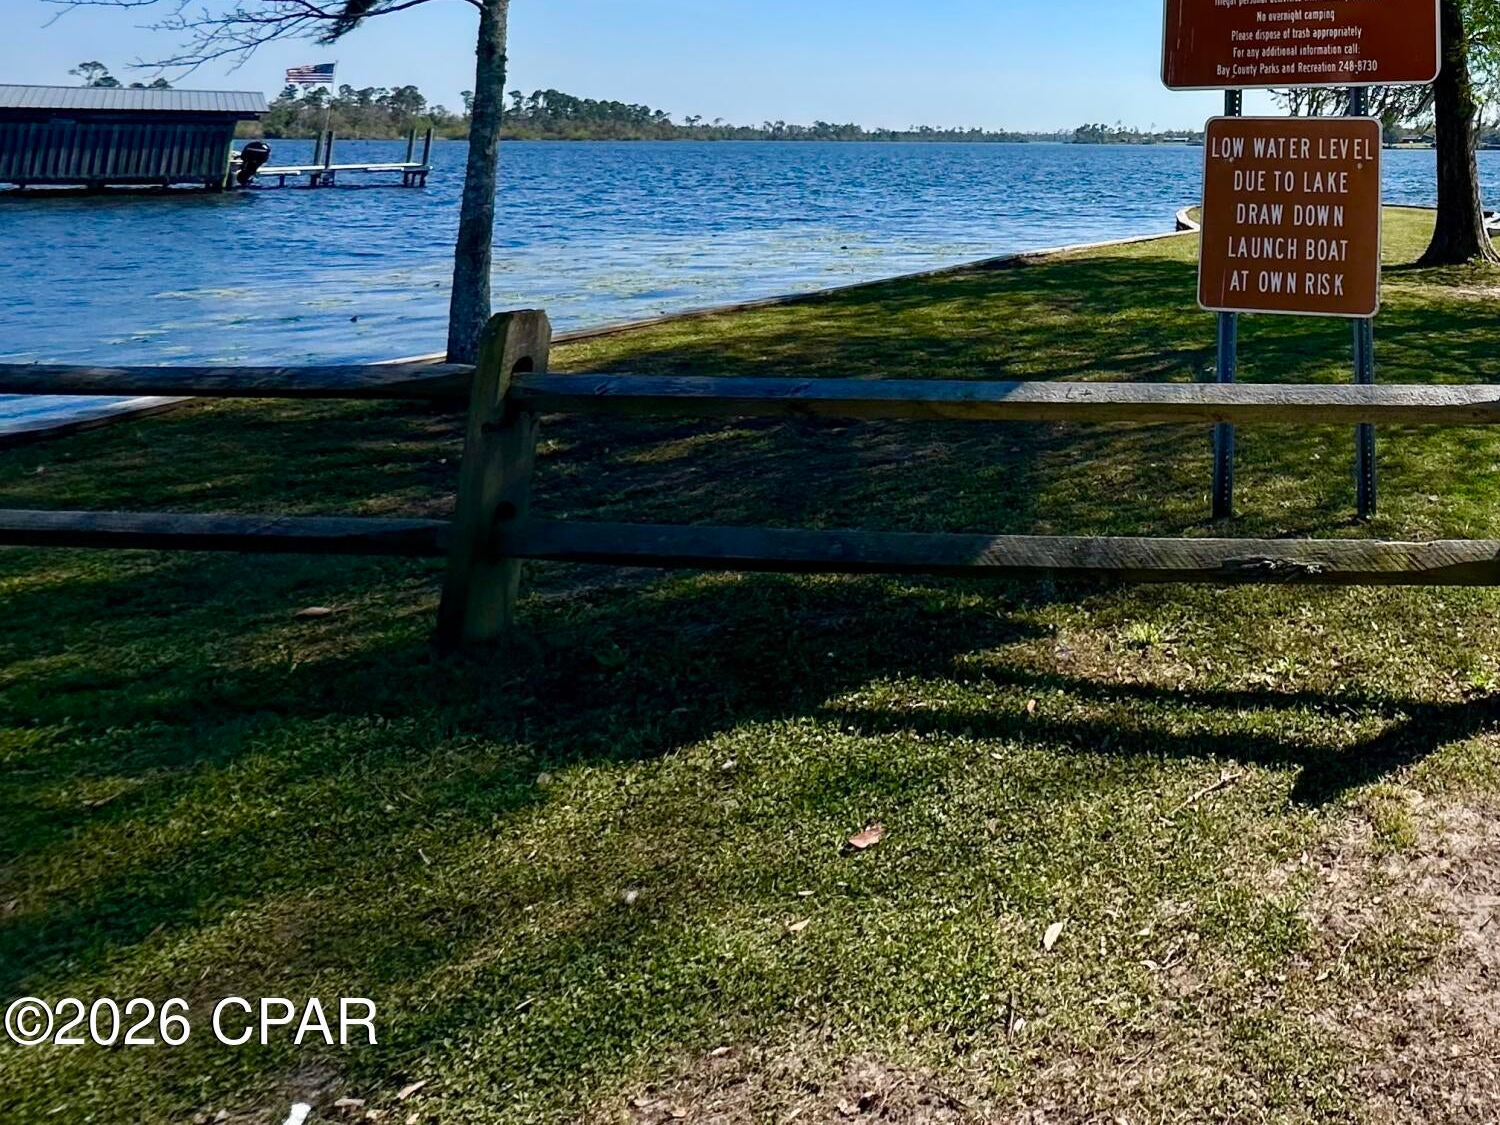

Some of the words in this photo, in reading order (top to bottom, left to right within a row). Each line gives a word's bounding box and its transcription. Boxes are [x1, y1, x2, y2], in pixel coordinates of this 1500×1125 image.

[1257, 11, 1266, 22] No
[1268, 9, 1302, 23] overnight
[1304, 9, 1335, 22] camping
[1231, 29, 1253, 41] Please
[1255, 29, 1280, 41] dispose
[1283, 28, 1290, 39] of
[1292, 27, 1310, 38] trash
[1313, 25, 1361, 40] appropriately
[1233, 47, 1244, 58] For
[1247, 47, 1259, 59] any
[1261, 45, 1297, 57] additional
[1300, 43, 1342, 55] information
[1344, 43, 1360, 54] call:
[1217, 64, 1231, 77] Bay
[1232, 64, 1257, 78] County
[1259, 63, 1280, 74] Parks
[1282, 62, 1295, 73] and
[1297, 61, 1336, 73] Recreation
[1211, 137, 1244, 158] LOW
[1254, 138, 1310, 159] WATER
[1319, 138, 1373, 160] LEVEL
[1234, 170, 1266, 192] DUE
[1274, 171, 1295, 192] TO
[1304, 172, 1348, 193] LAKE
[1236, 203, 1284, 225] DRAW
[1294, 205, 1344, 227] DOWN
[1228, 236, 1297, 260] LAUNCH
[1306, 239, 1348, 261] BOAT
[1230, 270, 1249, 292] AT
[1259, 271, 1296, 294] OWN
[1305, 273, 1344, 296] RISK
